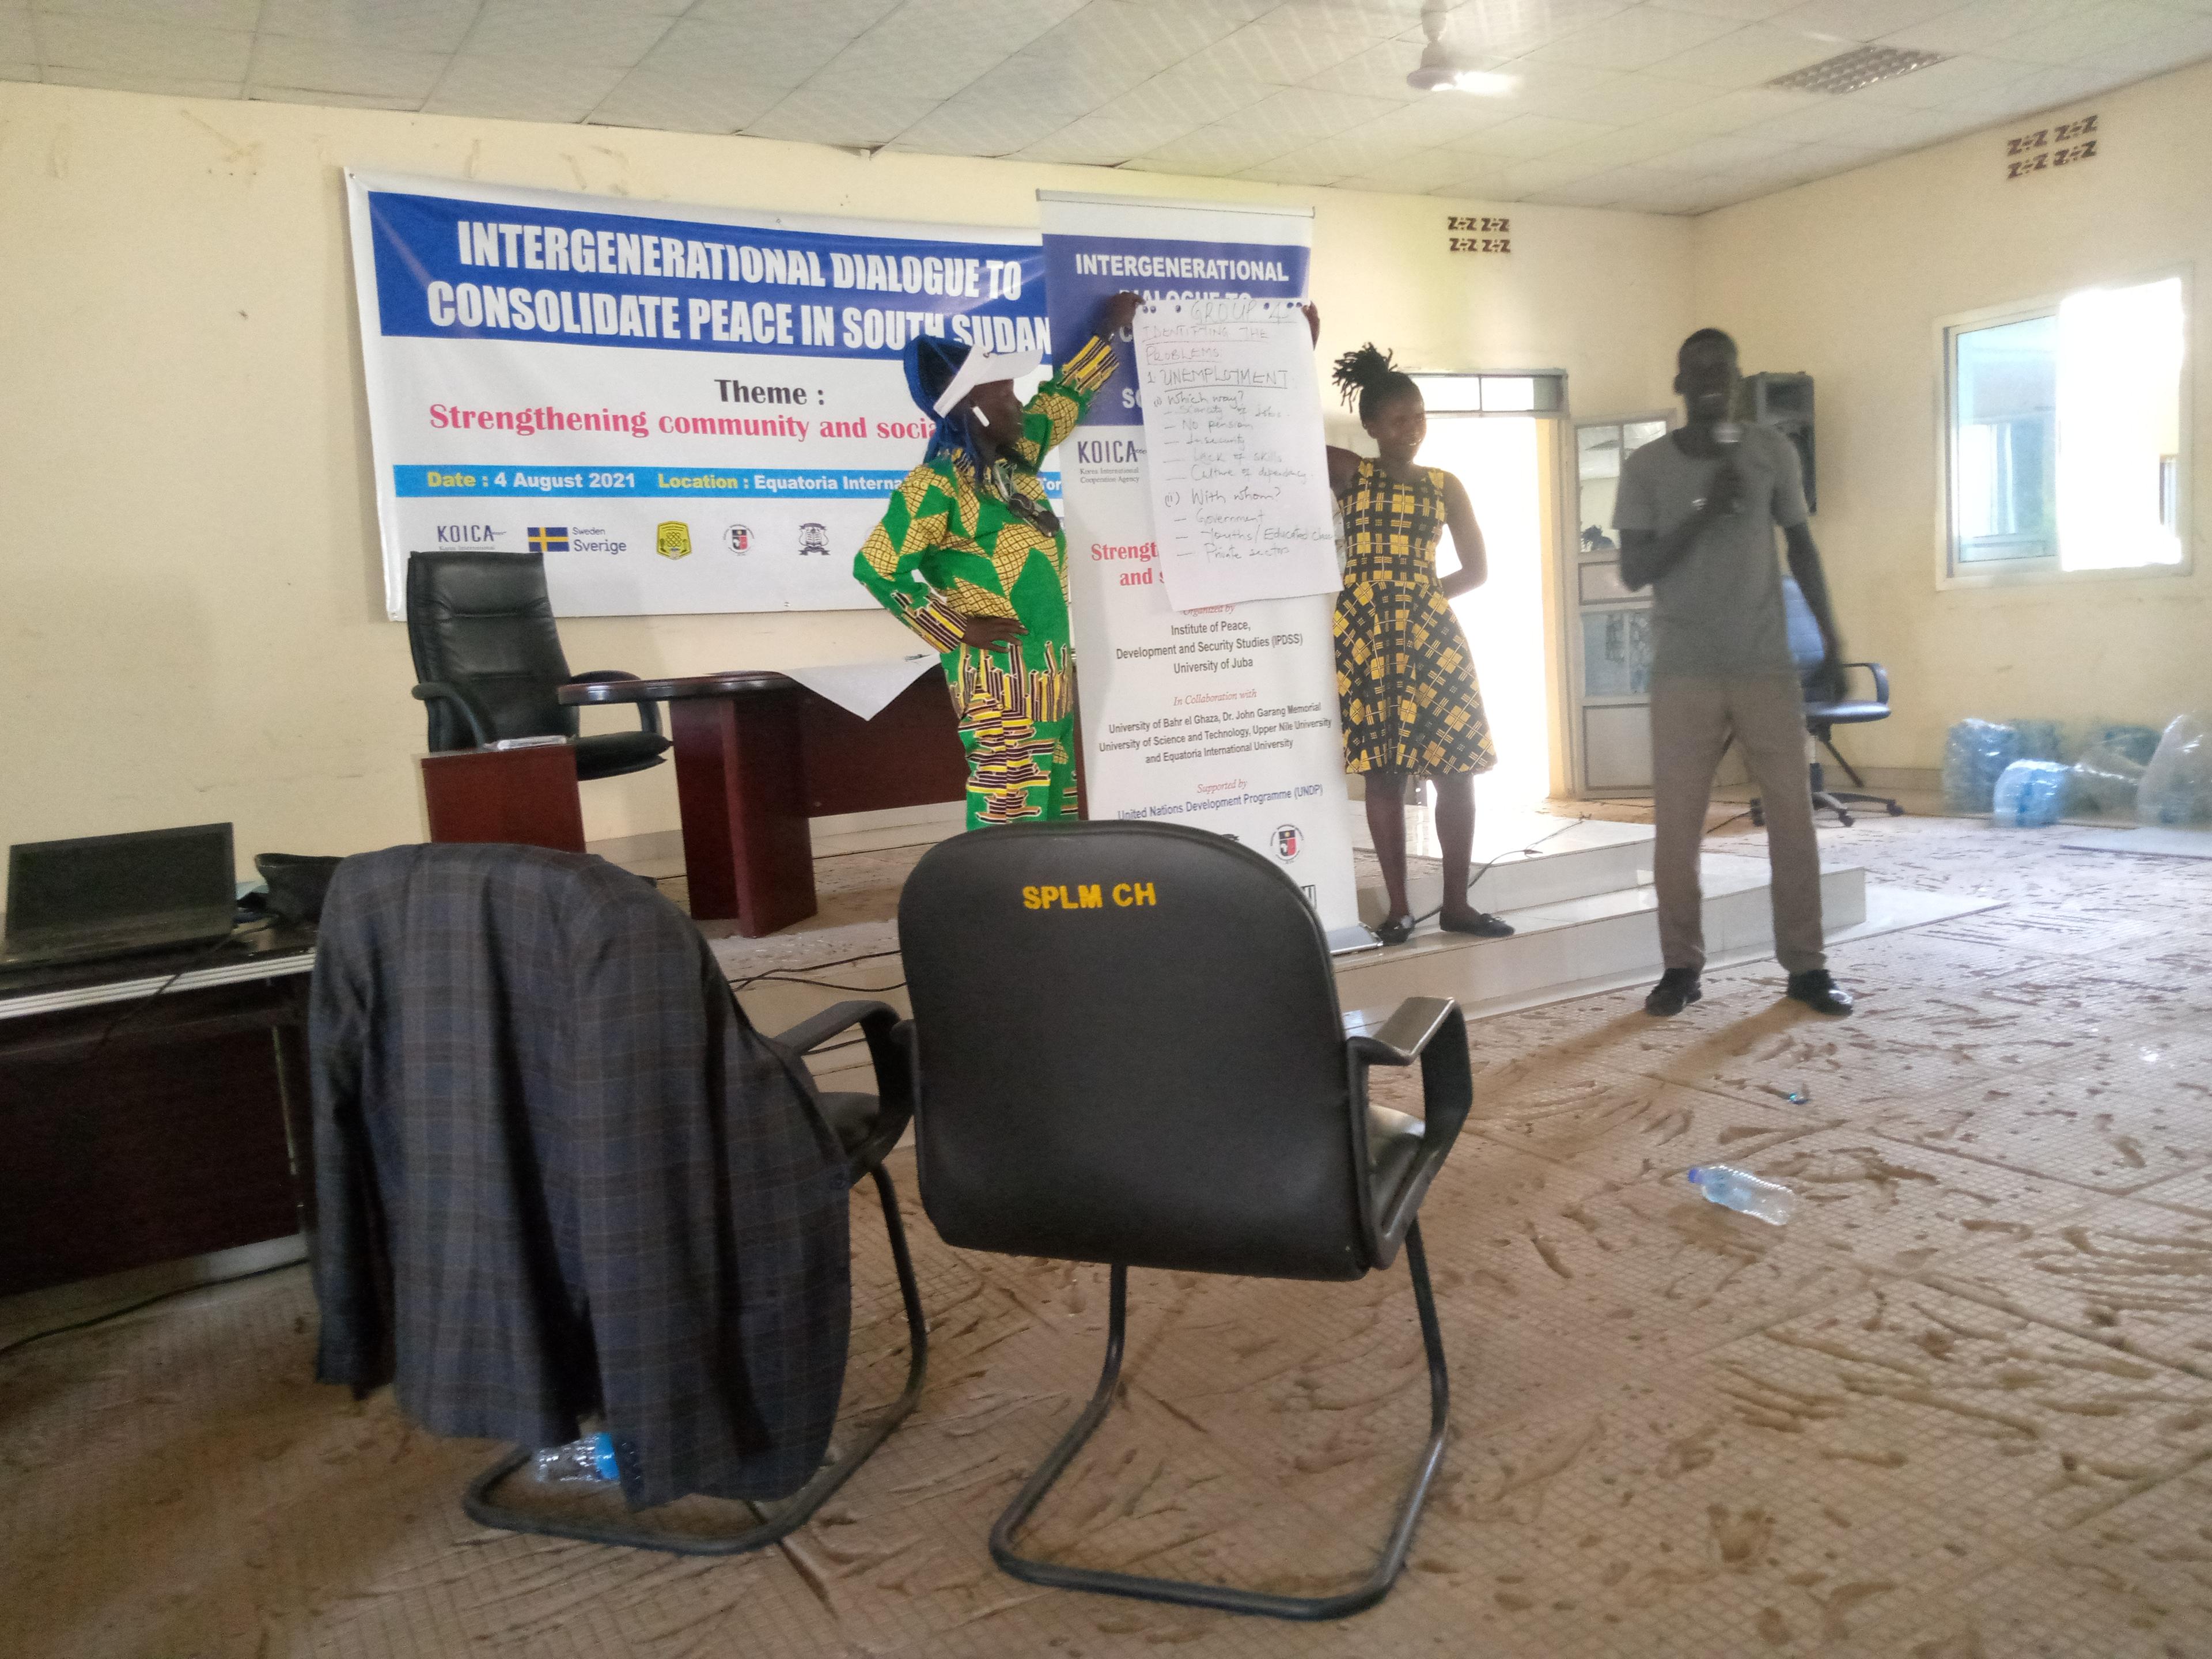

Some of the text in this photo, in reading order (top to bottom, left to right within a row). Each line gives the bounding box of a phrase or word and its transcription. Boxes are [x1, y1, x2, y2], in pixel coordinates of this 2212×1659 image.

[458, 221, 1021, 300] INTERGENERATIONAL DIALOGUE TO
[1076, 253, 1289, 282] INTERGENERATIONAL
[427, 281, 680, 339] CONSOLIDATE
[689, 298, 793, 344] PEACE
[801, 305, 834, 346] IN
[952, 314, 1051, 354] SUDAN
[1191, 300, 1257, 323] GROUP
[1239, 327, 1269, 339] THE
[1146, 346, 1219, 362] PROBLEMS
[714, 378, 808, 406] Theme
[430, 403, 649, 438] Strengthening
[658, 414, 809, 442] community
[820, 416, 865, 440] and
[1077, 441, 1138, 464] KOICA
[427, 471, 476, 487] Date
[494, 472, 507, 487] 4
[514, 472, 583, 491] August
[589, 473, 635, 488] 2021
[658, 474, 738, 489] Location
[755, 475, 836, 492] Equatoria
[1192, 488, 1226, 505] With
[437, 525, 494, 543] KOICA
[572, 527, 605, 536] Sweden
[574, 539, 627, 555] Sverige
[1120, 567, 1153, 586] and
[1171, 620, 1251, 635] Institute of Peace,
[1116, 634, 1304, 660] Development and Security Studies (IPDSS)
[1173, 657, 1253, 675] University of Juba
[1173, 689, 1257, 706] In Collaboration with
[1109, 721, 1151, 734] University
[1153, 719, 1161, 729] of
[1164, 716, 1182, 728] Bahr
[1185, 714, 1192, 725] el
[1222, 711, 1234, 721] Dr.
[1236, 708, 1255, 720] John
[1257, 707, 1286, 718] Garang
[1288, 702, 1321, 715] Memorial
[1099, 739, 1141, 752] University
[1143, 737, 1151, 747] of
[1153, 733, 1185, 745] Science
[1188, 731, 1202, 742] and
[1253, 724, 1277, 737] Upper
[1279, 721, 1293, 732] Nile
[1295, 717, 1332, 730] University
[1146, 737, 1294, 764] and Equatoria International University
[1198, 778, 1248, 794] Supported by
[1118, 783, 1324, 820] United Nations Development Programme (UNDP)
[1022, 881, 1157, 910] SPLM CH
